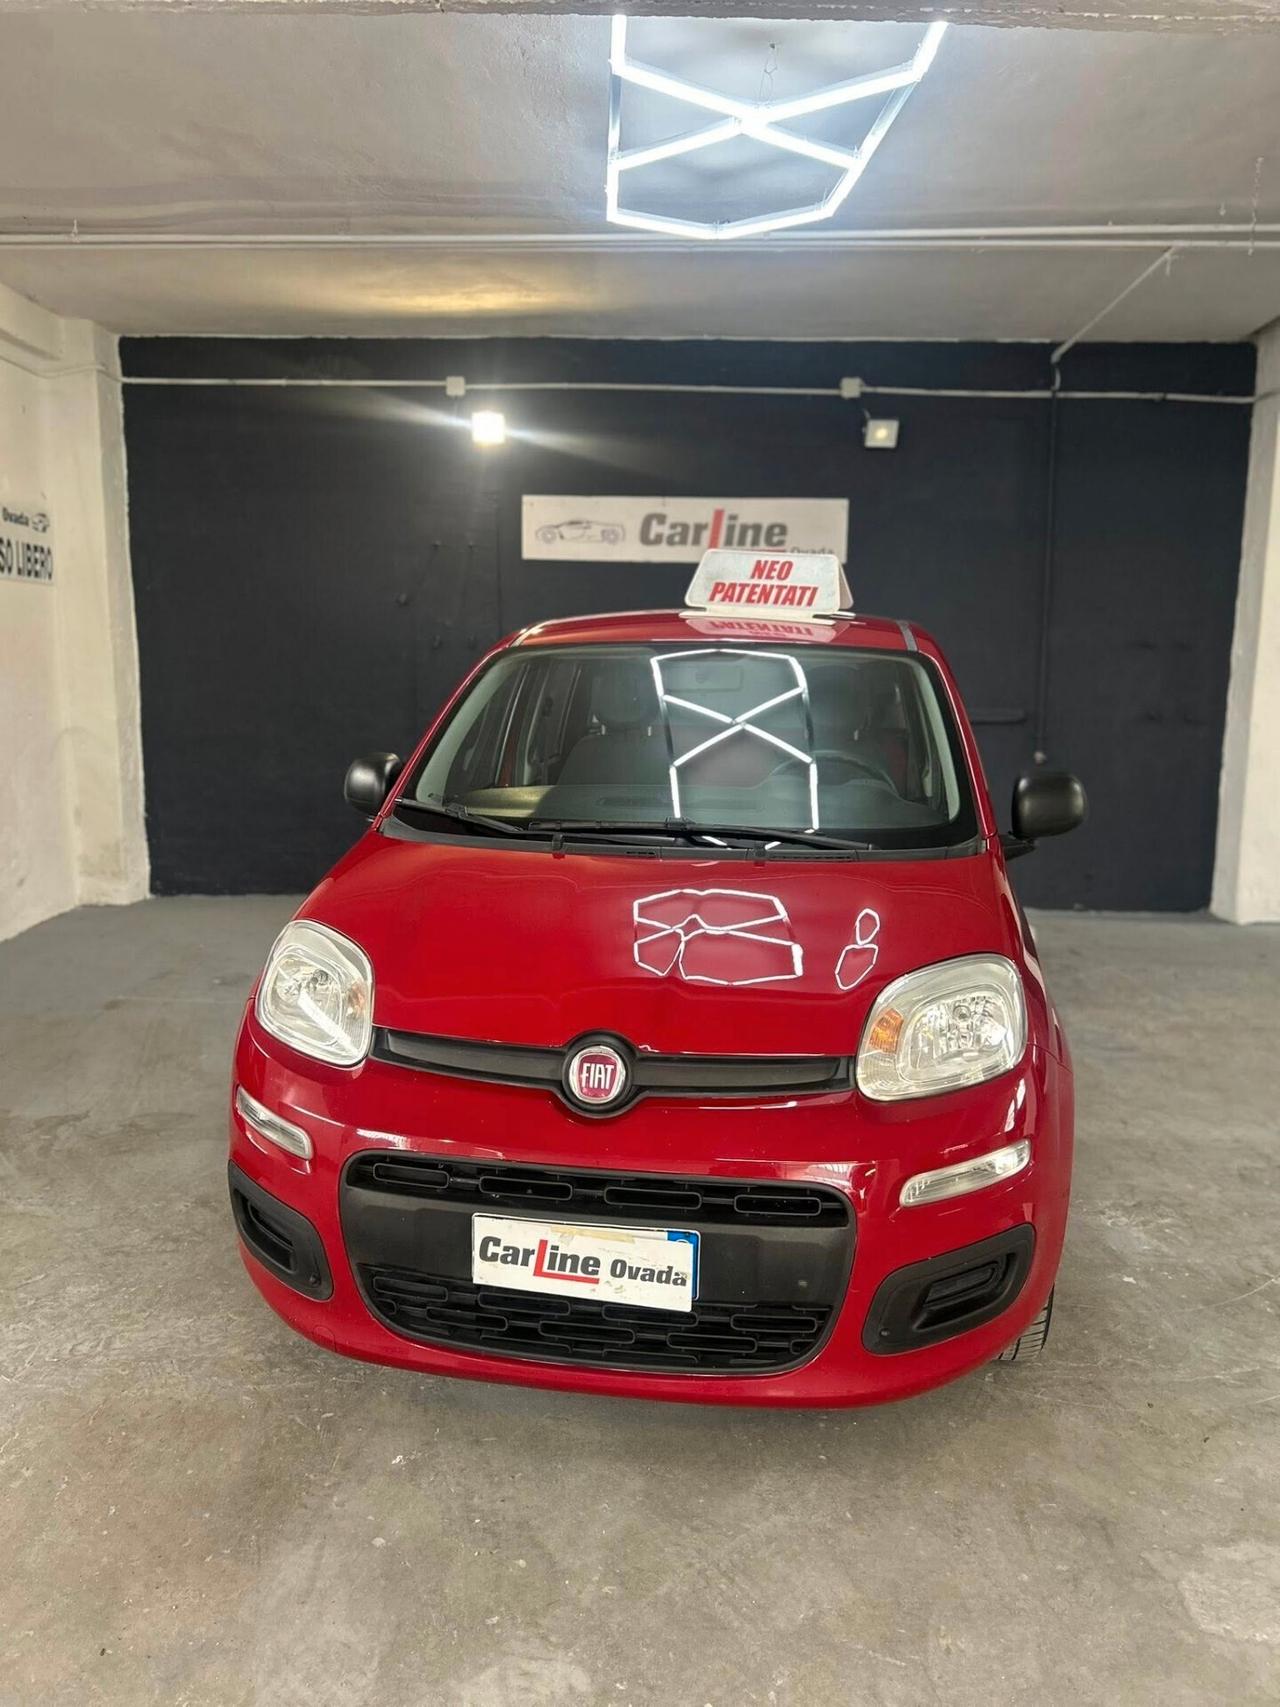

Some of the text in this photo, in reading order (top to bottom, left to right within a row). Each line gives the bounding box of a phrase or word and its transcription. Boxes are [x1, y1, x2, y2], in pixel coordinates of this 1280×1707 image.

[16, 540, 53, 580] LIBERO
[750, 559, 794, 581] NEO
[708, 582, 819, 607] PATENTATI
[581, 1062, 615, 1090] FIAT
[609, 1258, 688, 1287] Ovada
